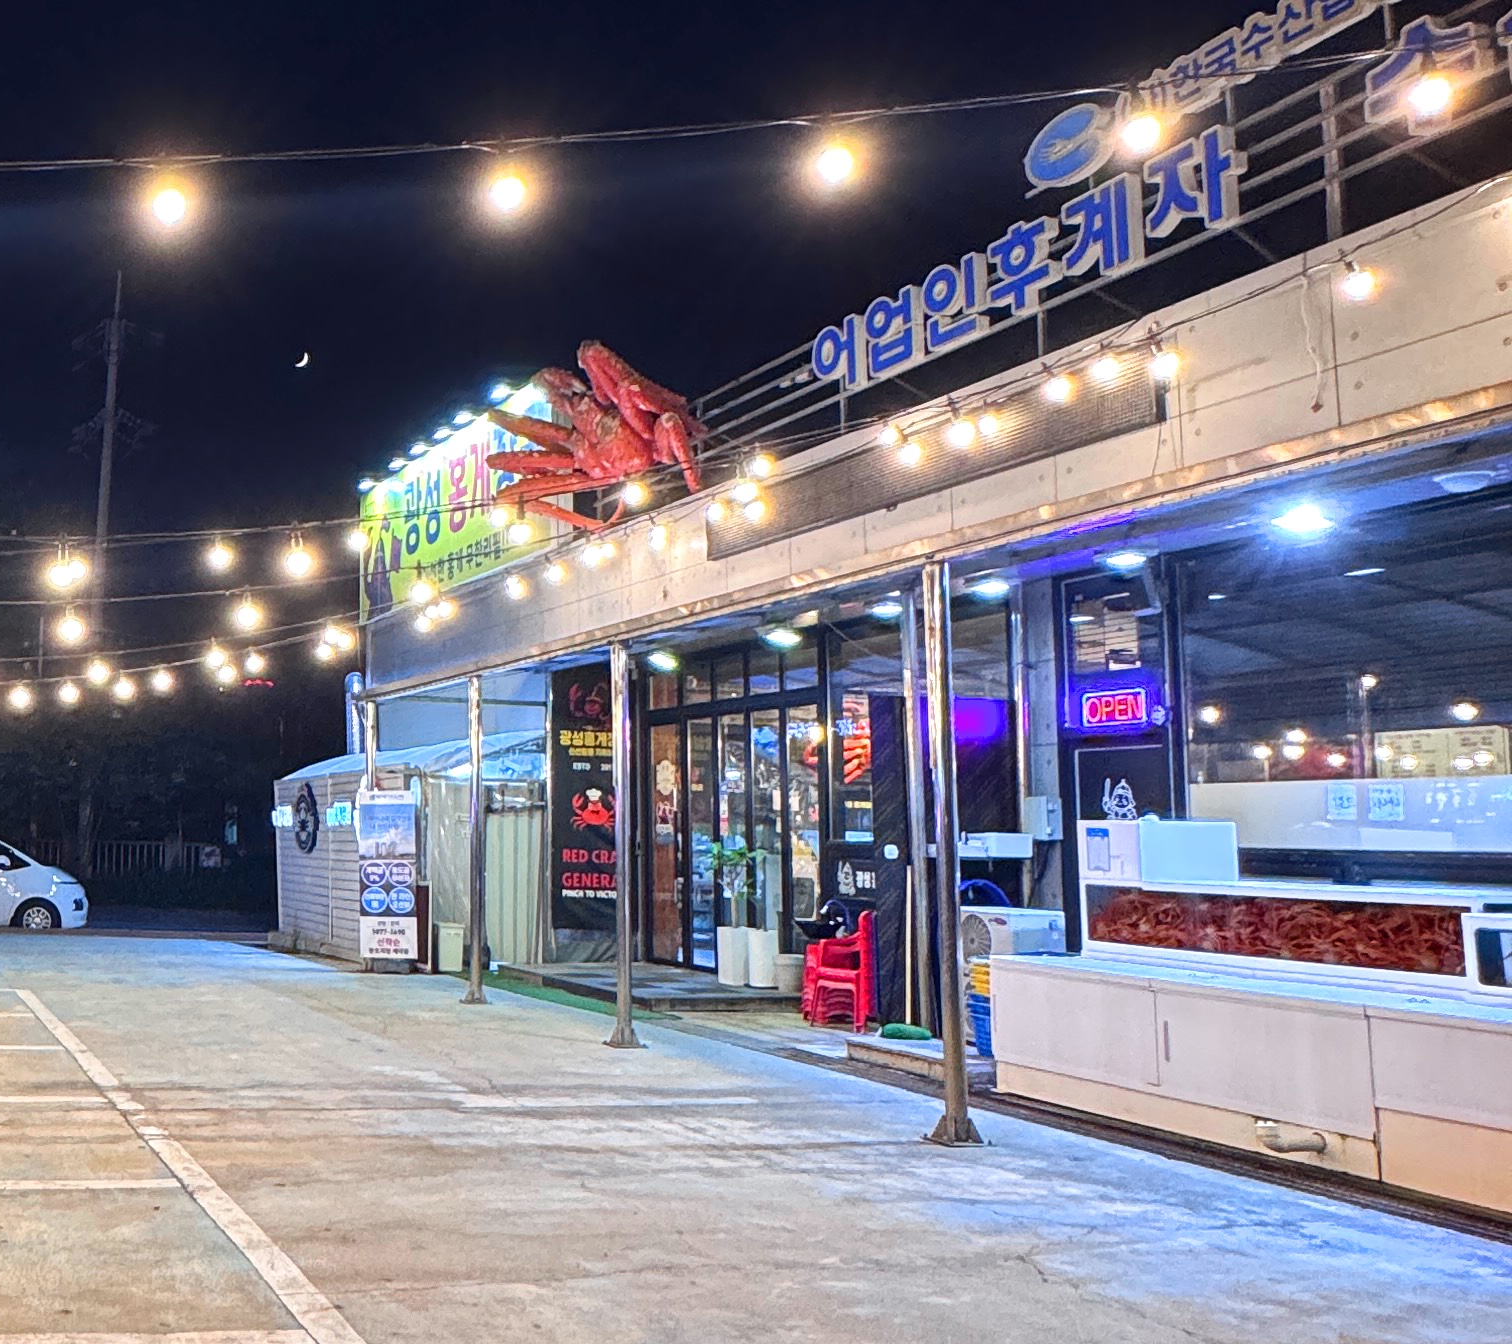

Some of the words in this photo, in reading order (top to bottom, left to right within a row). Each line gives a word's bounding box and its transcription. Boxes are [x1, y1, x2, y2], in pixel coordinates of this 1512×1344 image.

[811, 128, 1234, 387] 어업인후계자
[1086, 694, 1142, 723] OPEN
[562, 848, 588, 863] RED
[591, 850, 617, 864] CRA
[561, 872, 617, 888] GENERA
[584, 890, 595, 898] TO
[596, 890, 617, 899] VICTO
